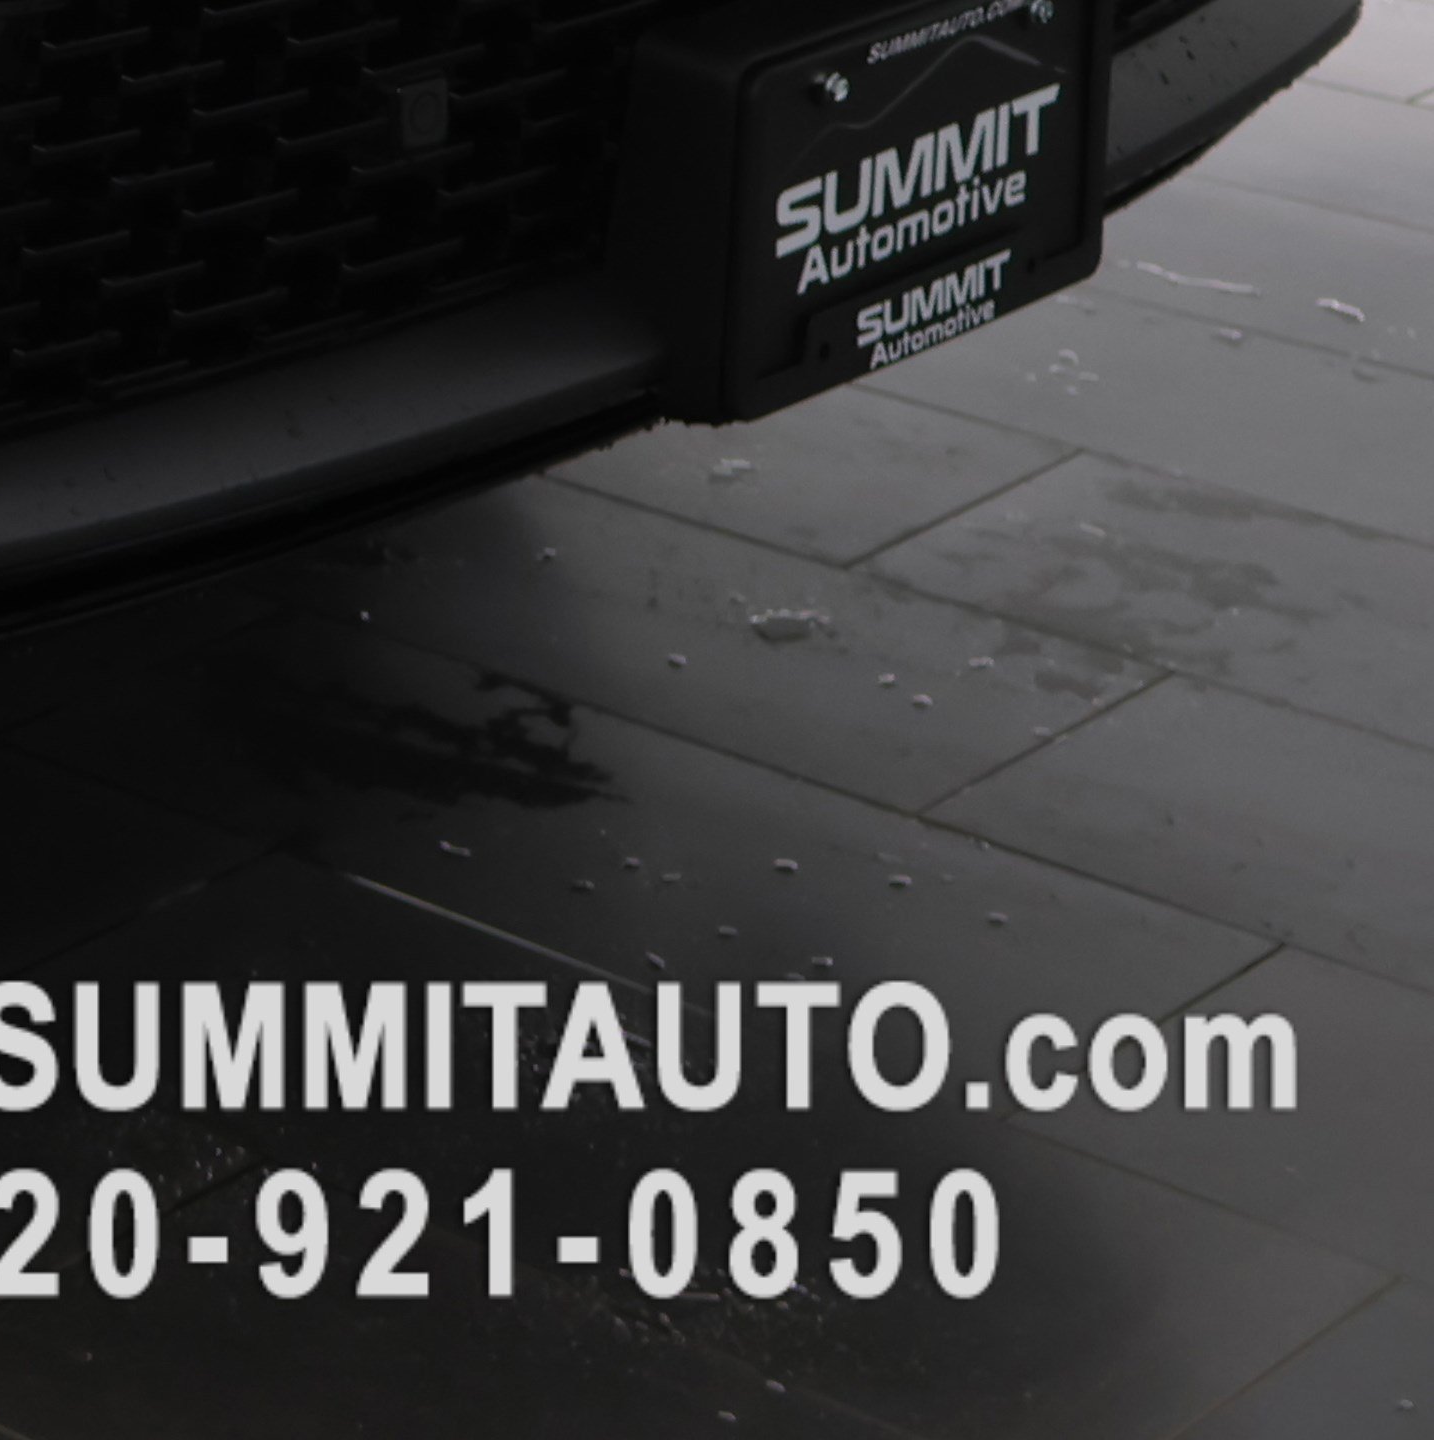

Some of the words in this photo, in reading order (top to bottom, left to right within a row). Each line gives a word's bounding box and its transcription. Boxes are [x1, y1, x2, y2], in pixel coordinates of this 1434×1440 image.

[775, 82, 1061, 259] SUMMIT
[797, 170, 1027, 295] Automotive
[856, 248, 1012, 349] SUMMIT
[869, 298, 996, 371] Automotive
